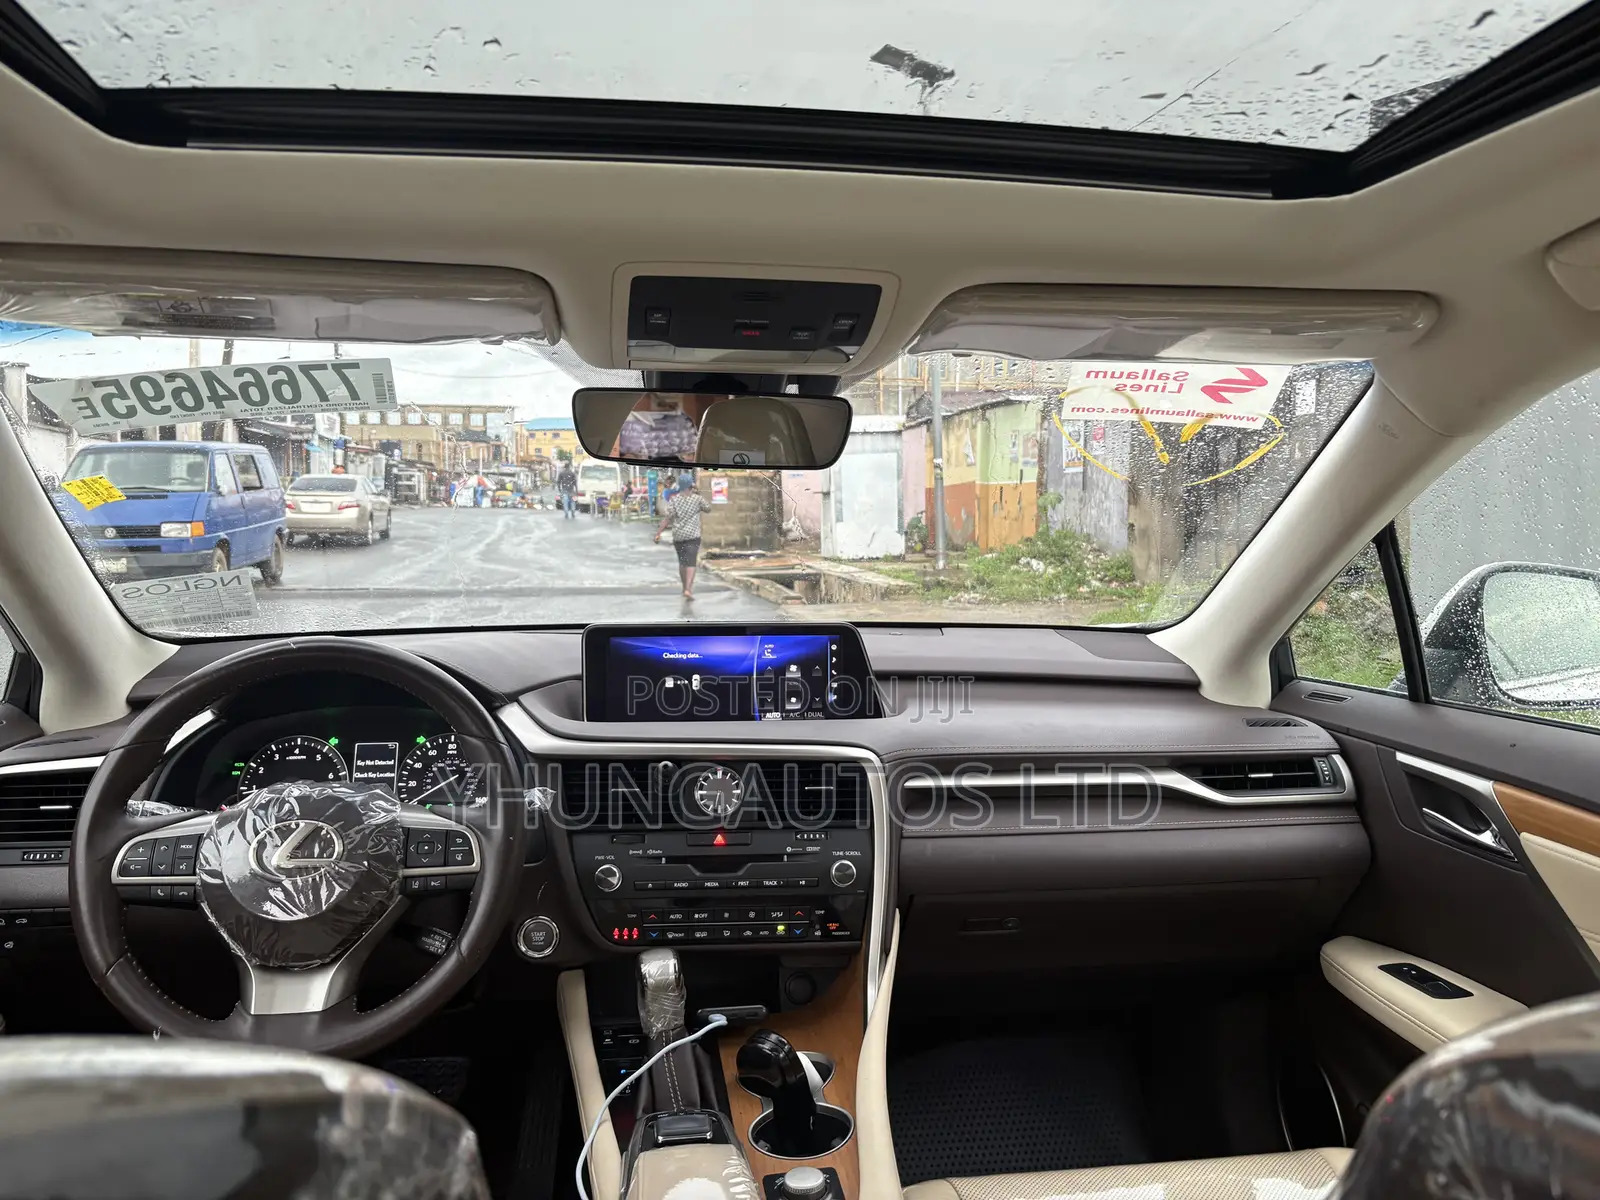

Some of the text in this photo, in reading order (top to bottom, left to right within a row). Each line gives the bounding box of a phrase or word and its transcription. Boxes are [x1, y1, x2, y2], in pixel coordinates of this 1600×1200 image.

[274, 753, 280, 761] 3
[316, 753, 322, 761] 5
[258, 766, 265, 774] 2
